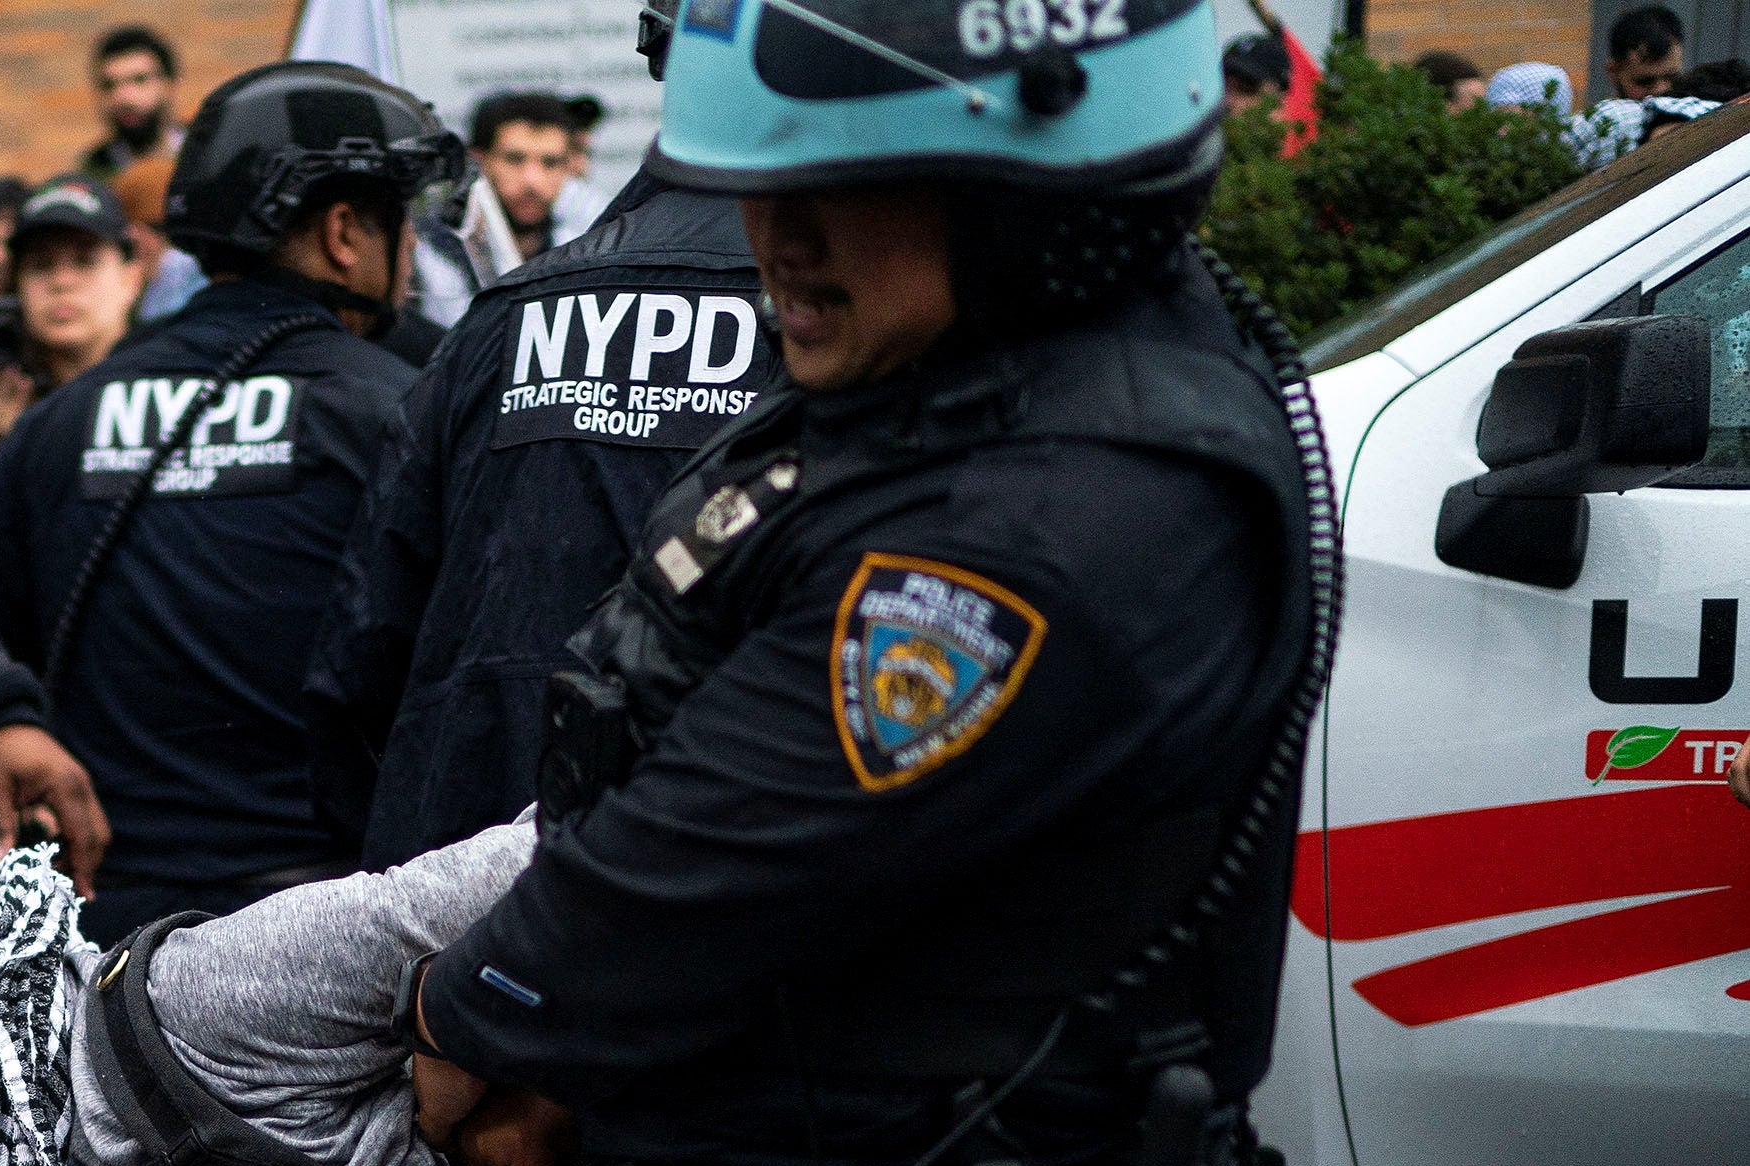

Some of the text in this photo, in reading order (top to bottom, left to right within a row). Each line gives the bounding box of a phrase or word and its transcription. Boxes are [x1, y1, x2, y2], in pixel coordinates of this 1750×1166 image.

[958, 0, 1130, 56] 6932
[512, 293, 757, 384] NYPD
[93, 375, 293, 447] NYPD
[500, 380, 618, 414] STRATEGIC
[573, 407, 659, 438] GROUP
[190, 441, 293, 467] RESPONSE
[902, 572, 996, 625] POLICE
